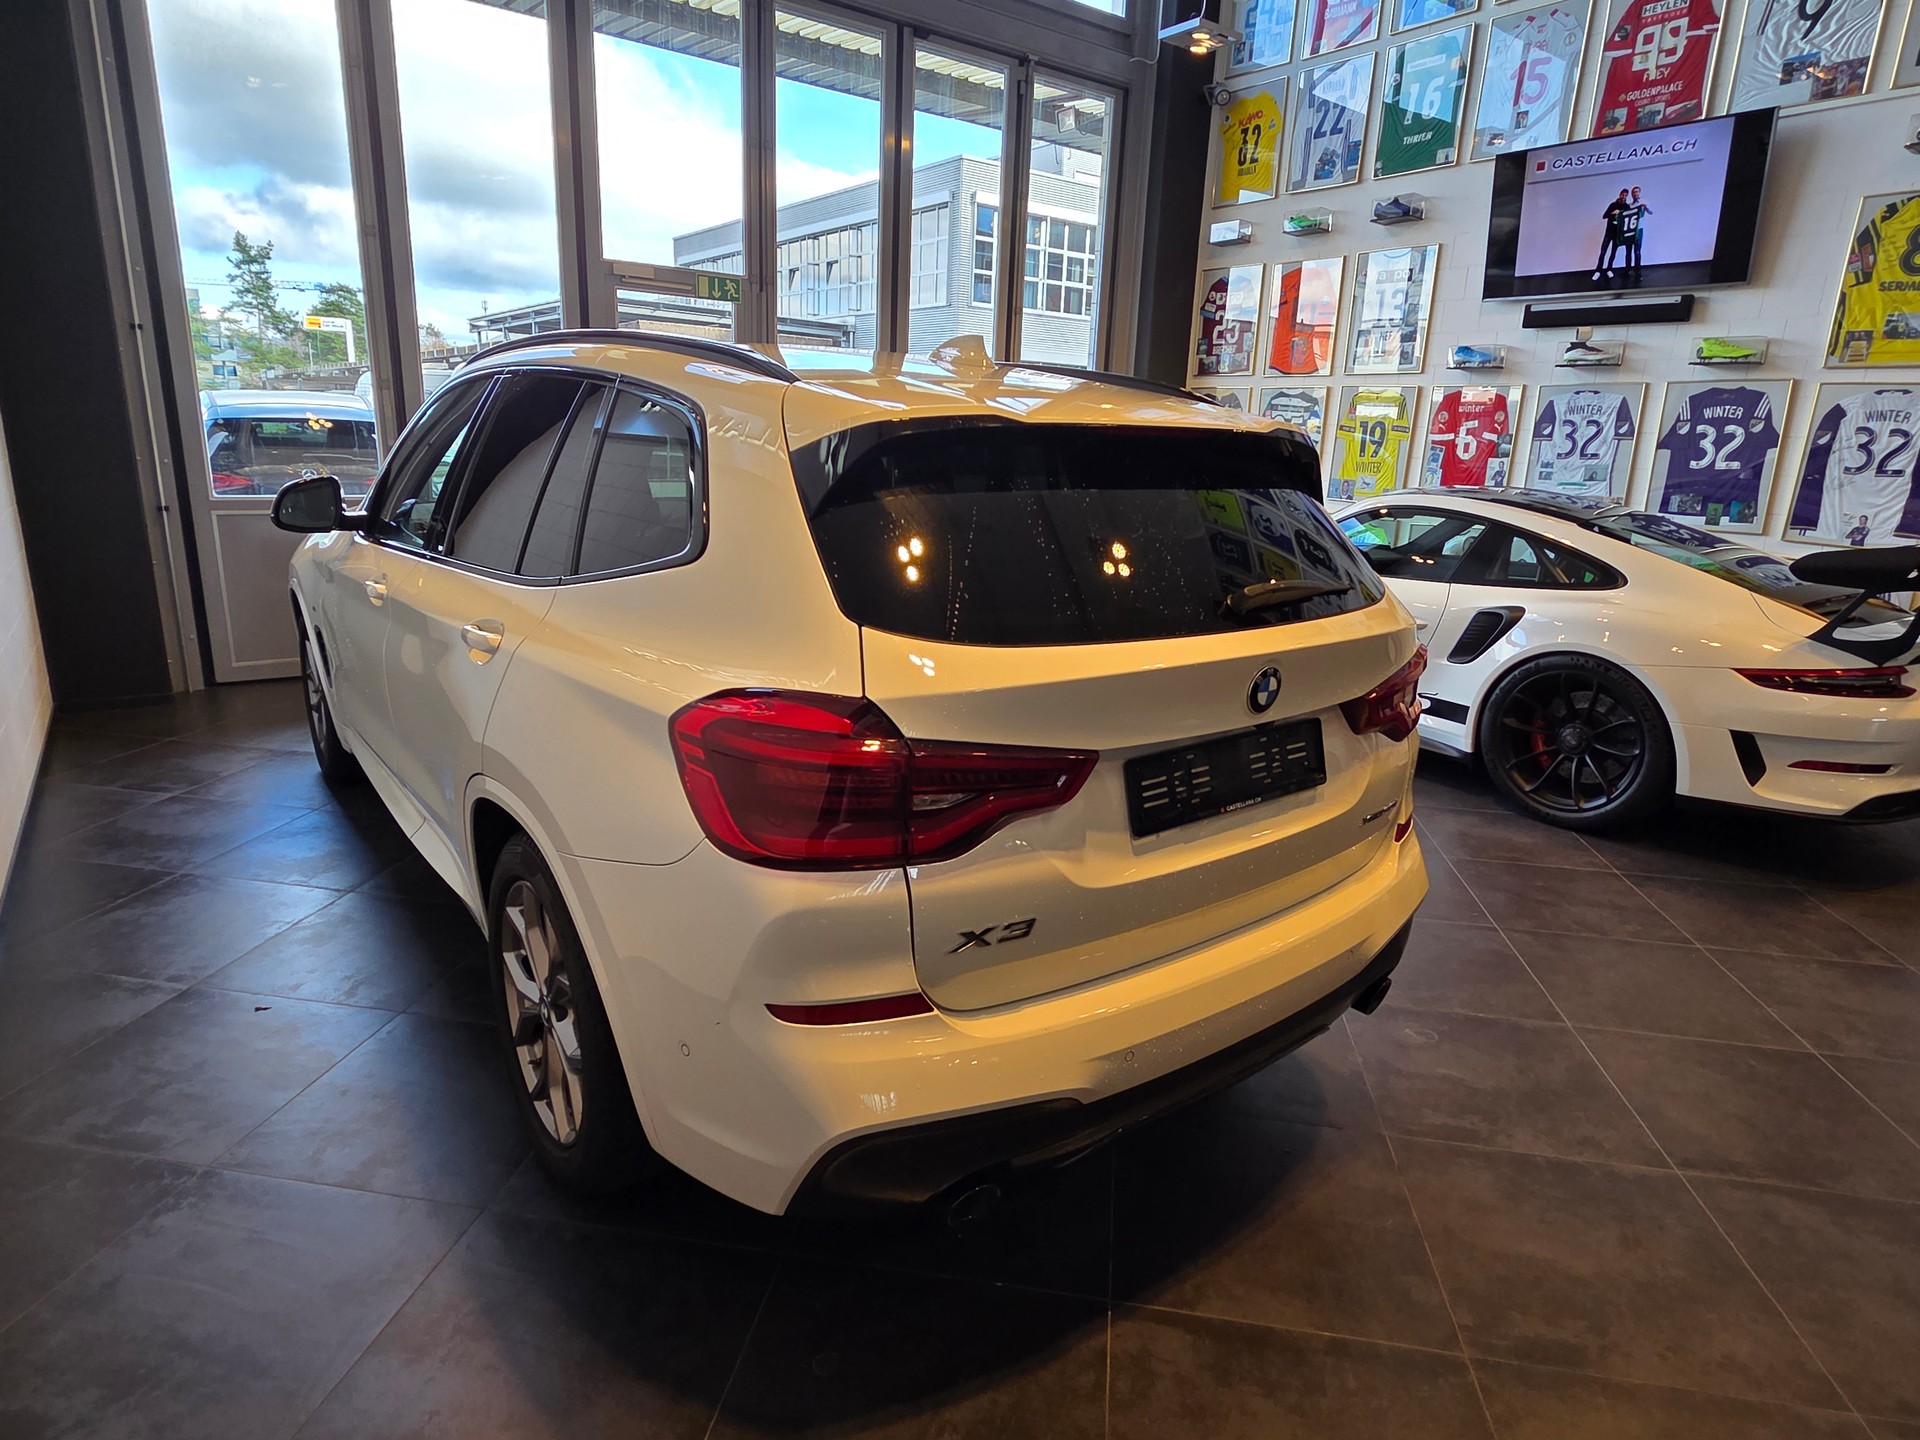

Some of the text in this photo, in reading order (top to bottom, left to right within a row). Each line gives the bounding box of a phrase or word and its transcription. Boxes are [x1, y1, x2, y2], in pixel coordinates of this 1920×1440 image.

[1643, 0, 1688, 15] HEYLEN
[1632, 17, 1689, 71] 99
[1404, 76, 1444, 125] 16
[1510, 57, 1552, 107] 15
[1627, 80, 1683, 101] GOLDENPALACE
[1313, 95, 1348, 140] 22
[1237, 124, 1261, 167] 32
[1552, 139, 1698, 169] CASTELLANA.CH
[1623, 215, 1638, 231] 16
[1567, 404, 1604, 416] WINTER
[1703, 405, 1744, 419] WINTER
[1864, 409, 1913, 424] WINTER
[1359, 420, 1387, 458] 19
[1455, 420, 1478, 460] 6
[1556, 419, 1604, 460] 32
[1689, 424, 1745, 470] 32
[1843, 426, 1914, 477] 32
[1355, 461, 1382, 474] WINTER
[944, 918, 1037, 954] X3
